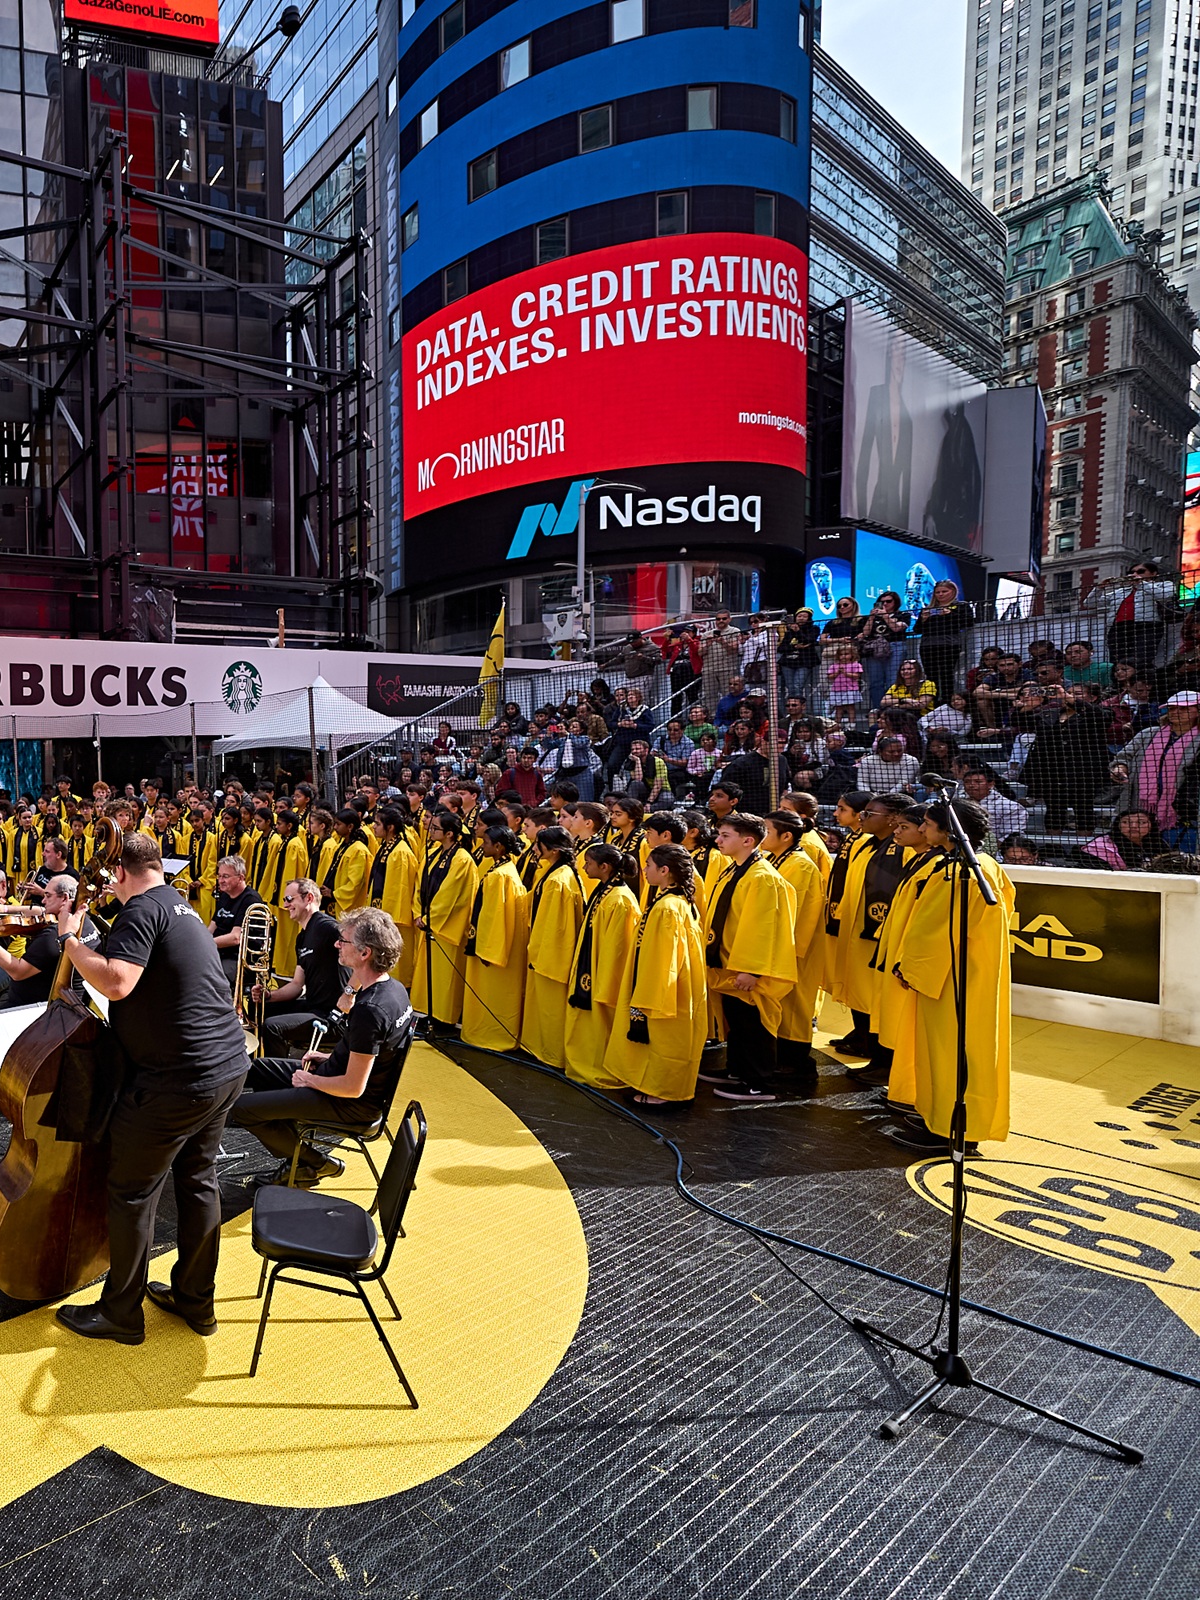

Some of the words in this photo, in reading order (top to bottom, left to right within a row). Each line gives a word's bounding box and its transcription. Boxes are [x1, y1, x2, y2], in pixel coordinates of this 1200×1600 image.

[416, 310, 500, 374] DATA.
[511, 261, 660, 329] CREDIT
[671, 255, 802, 308] RATINGS.
[417, 326, 567, 411] INDEXES.
[580, 300, 807, 355] INVESTMENTS.
[417, 418, 565, 493] MORNINGSTAR
[599, 486, 761, 533] Nasdaq
